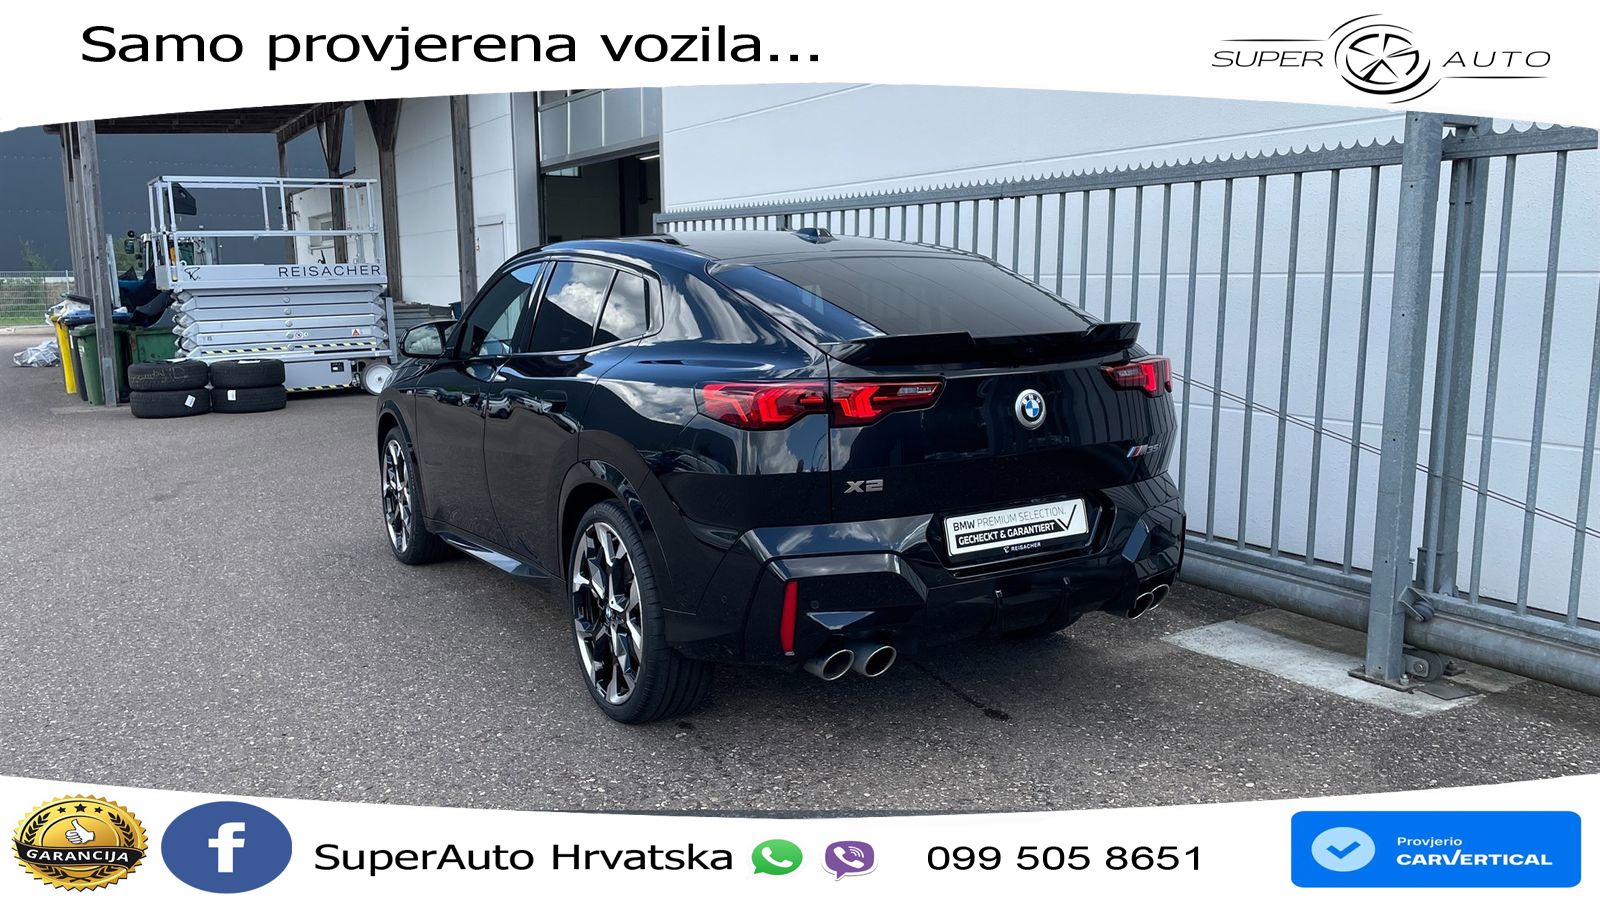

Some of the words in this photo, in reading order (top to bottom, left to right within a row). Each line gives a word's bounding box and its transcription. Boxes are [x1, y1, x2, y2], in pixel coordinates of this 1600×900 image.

[278, 264, 381, 278] REISACHER
[843, 479, 884, 494] X2
[953, 520, 975, 532] BMW
[977, 514, 1018, 528] PREMIUM
[958, 531, 999, 546] GECHECKT
[999, 531, 1007, 539] &
[1007, 522, 1055, 537] GARANTIERT
[1010, 541, 1041, 551] REISACHER
